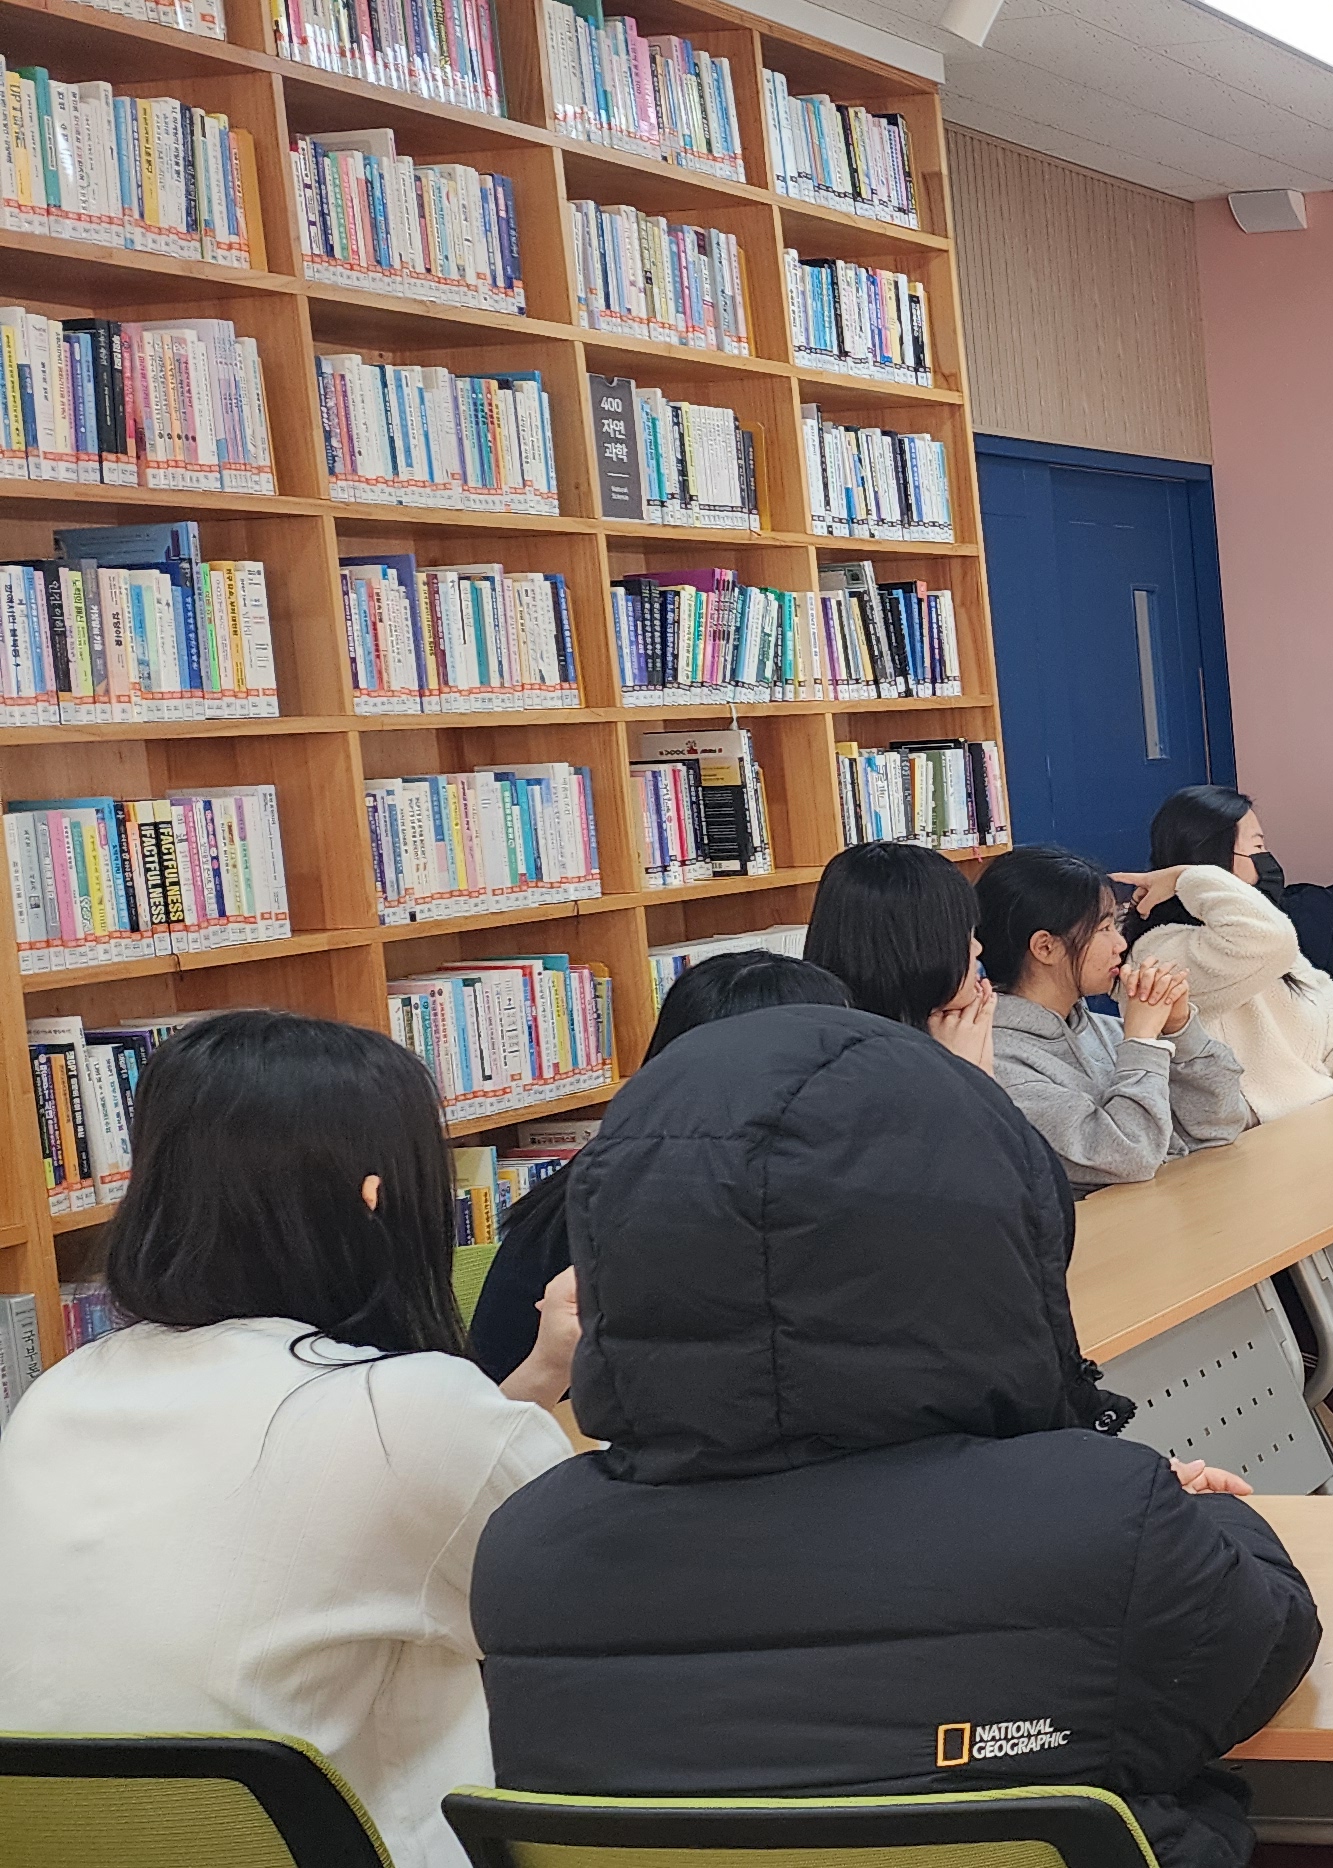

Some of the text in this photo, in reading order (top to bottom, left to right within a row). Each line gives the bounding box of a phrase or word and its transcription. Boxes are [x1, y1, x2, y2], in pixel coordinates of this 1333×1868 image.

[600, 396, 622, 413] 400
[601, 418, 626, 440] 자연
[604, 443, 628, 463] 과학
[141, 827, 167, 924] FACTFULNESS
[160, 825, 185, 922] FACTFULNESS
[974, 1717, 1055, 1743] NATIONAL
[972, 1730, 1072, 1760] GEOGRAPHIC
